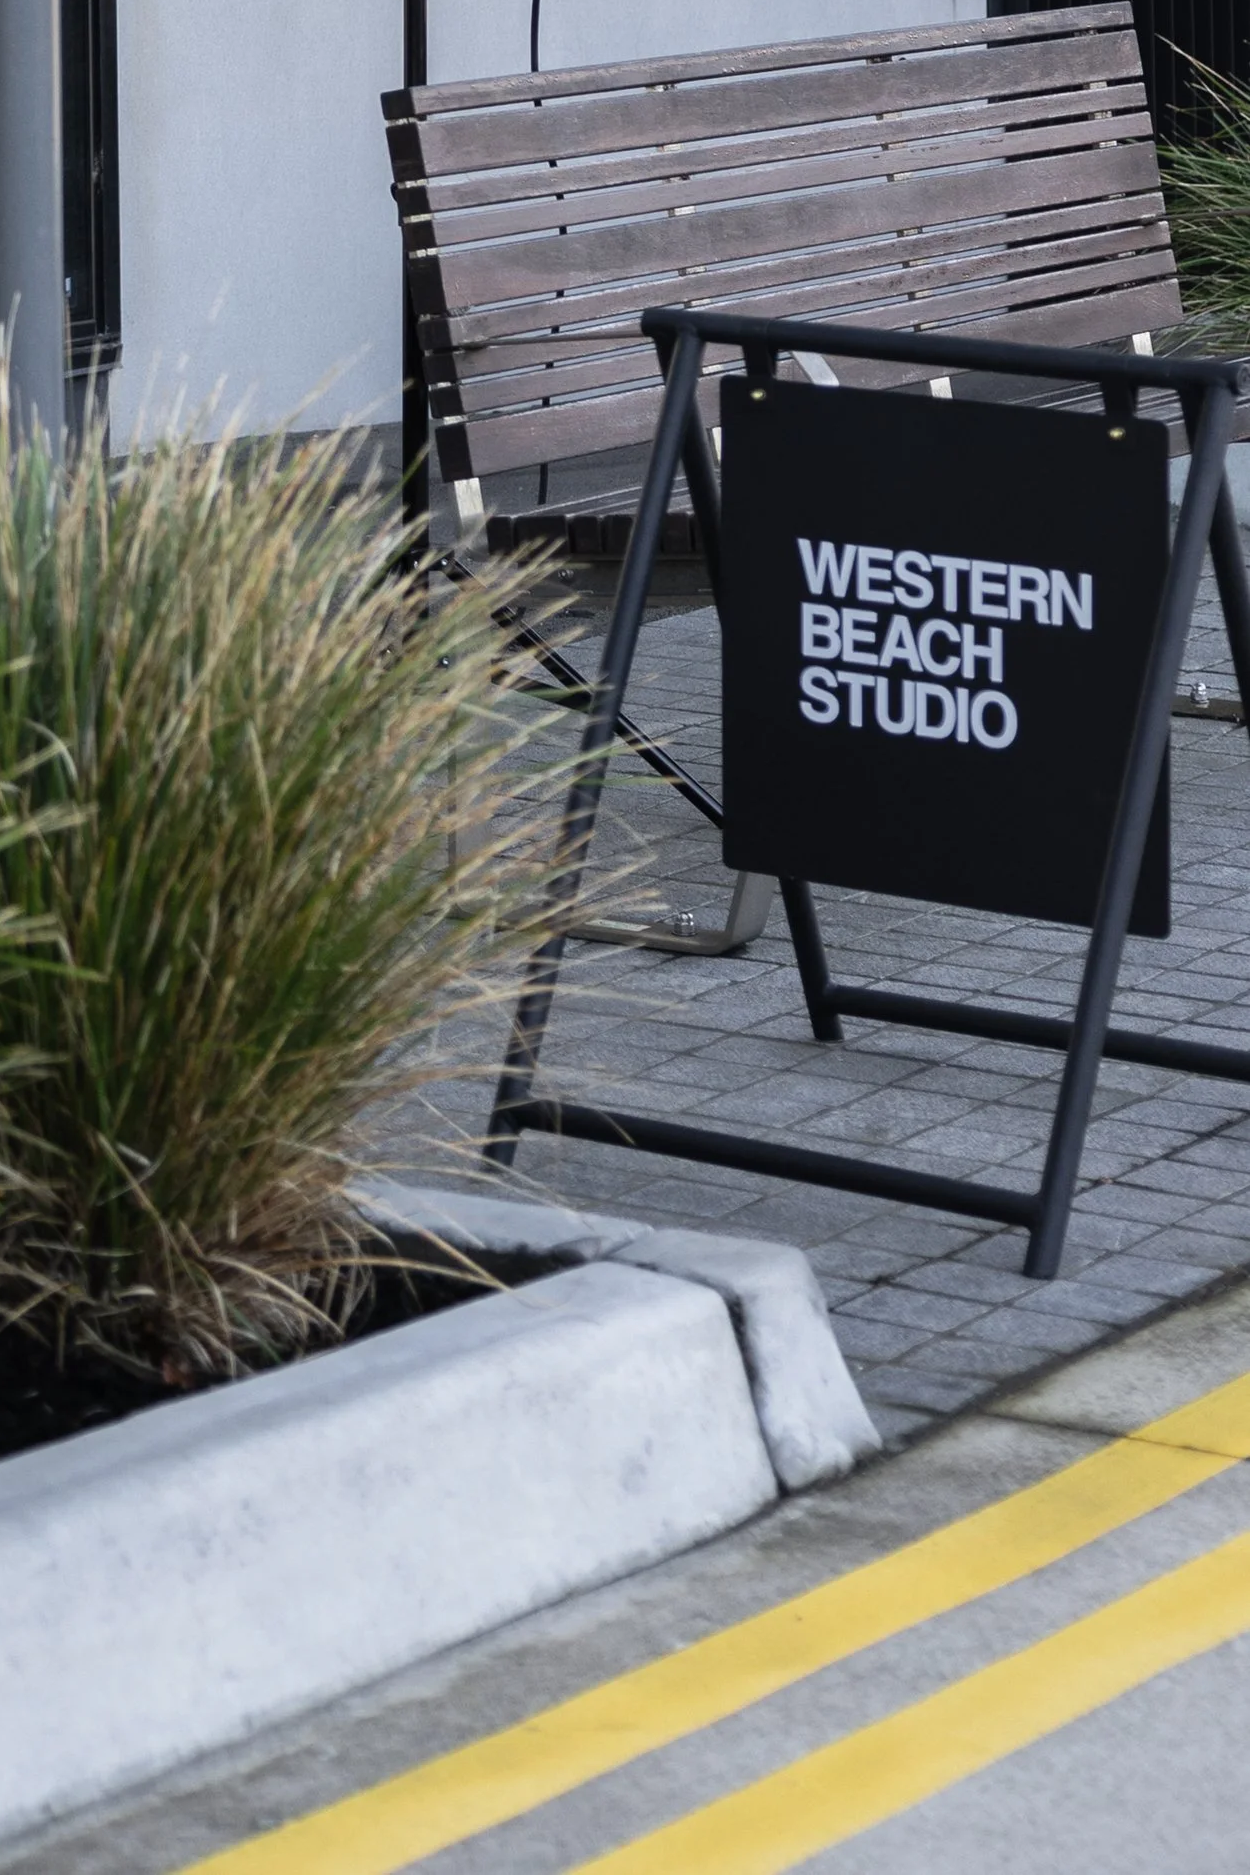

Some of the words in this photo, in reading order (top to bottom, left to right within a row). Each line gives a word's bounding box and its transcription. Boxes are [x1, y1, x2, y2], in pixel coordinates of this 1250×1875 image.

[796, 537, 1094, 630] WESTERN
[800, 602, 1004, 683] BEACH
[798, 665, 1019, 750] STUDIO
